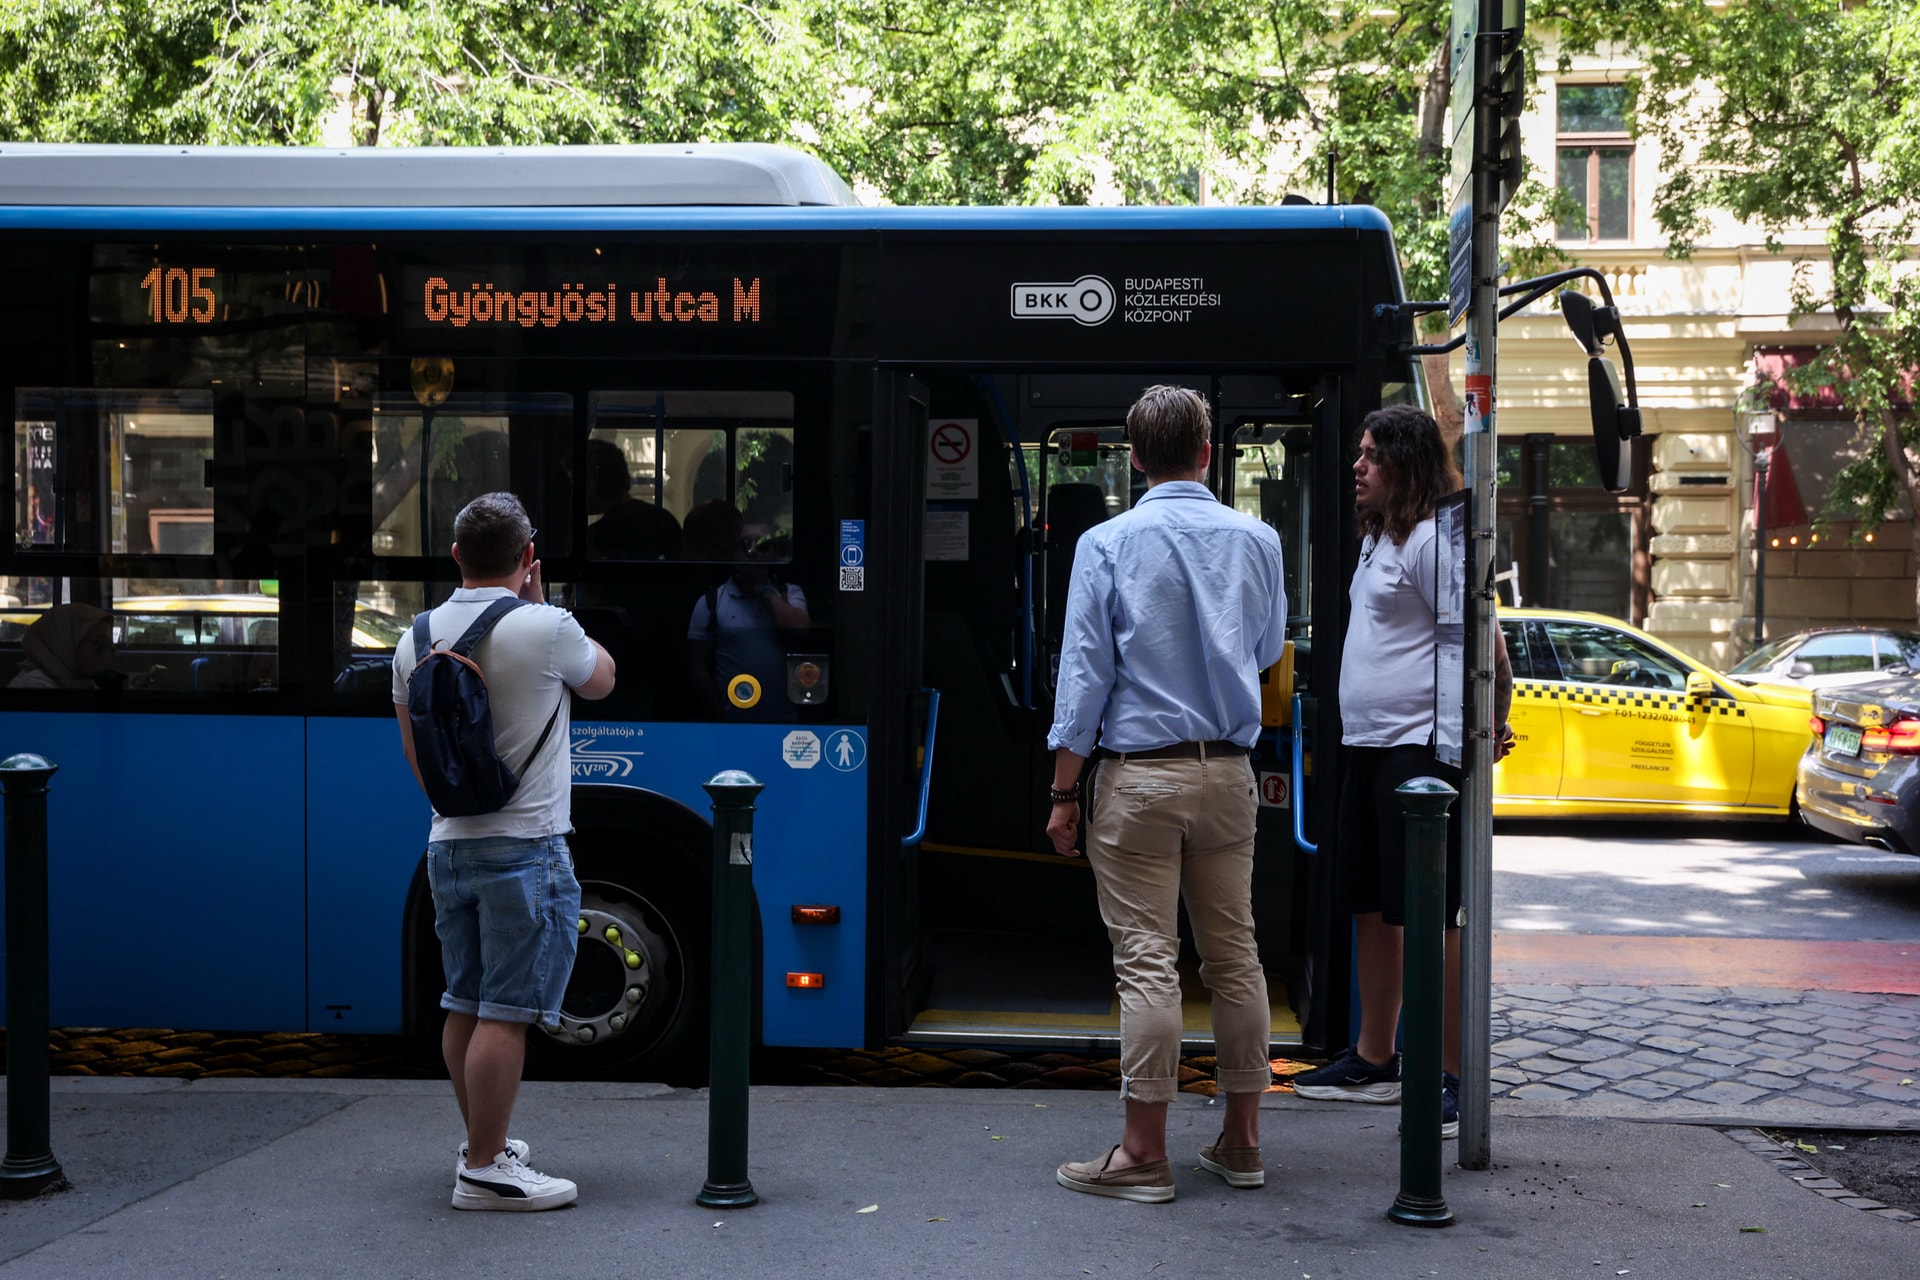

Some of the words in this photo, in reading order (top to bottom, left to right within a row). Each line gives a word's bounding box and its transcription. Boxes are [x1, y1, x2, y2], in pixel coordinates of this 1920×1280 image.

[1124, 278, 1204, 290] BUDAPESTI
[140, 267, 215, 323] 105
[424, 277, 616, 327] Gyöngyösi
[630, 277, 719, 322] utca
[733, 277, 760, 322] M
[1025, 293, 1069, 308] BKK
[1124, 292, 1221, 306] KÖZLEKEDÉSI
[1124, 308, 1193, 322] KÖZPONT
[571, 726, 635, 738] szolgáltatója
[637, 728, 644, 736] a
[571, 763, 593, 776] KV
